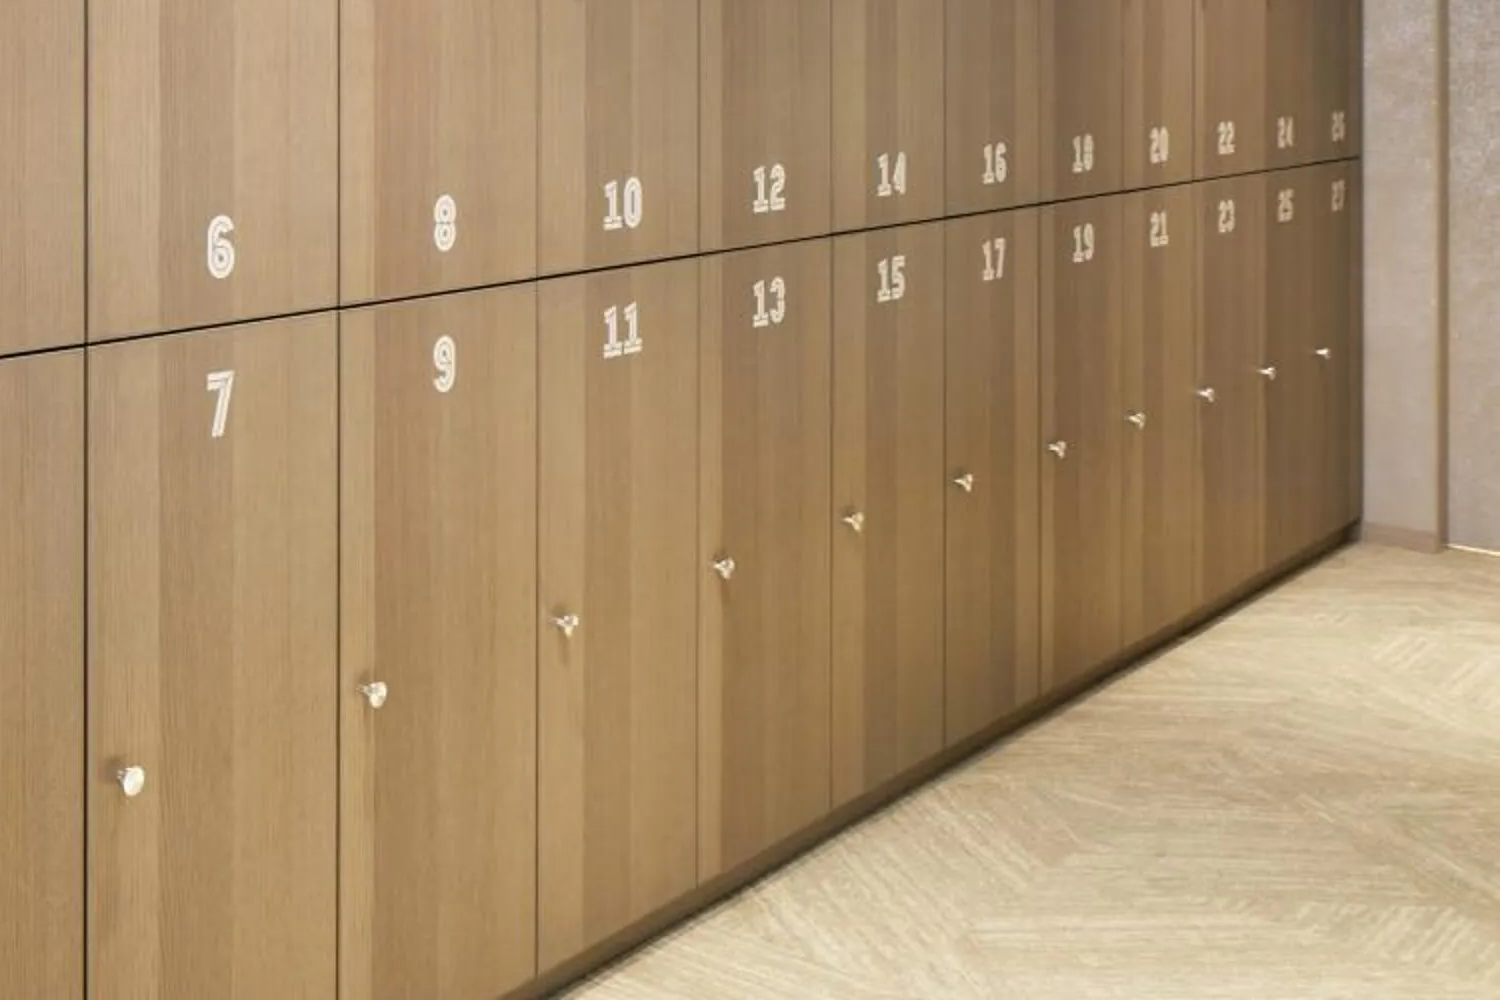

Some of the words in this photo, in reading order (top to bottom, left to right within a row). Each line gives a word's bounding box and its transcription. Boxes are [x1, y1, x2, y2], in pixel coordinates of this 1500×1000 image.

[1072, 134, 1094, 173] 18
[1150, 127, 1169, 164] 20
[1217, 121, 1235, 155] 22
[1277, 117, 1293, 149] 24
[877, 151, 906, 197] 14
[982, 142, 1007, 184] 16
[604, 176, 642, 230] 10
[753, 163, 786, 213] 12
[1278, 189, 1293, 222] 25
[433, 194, 457, 252] 8
[1150, 211, 1169, 247] 21
[1218, 199, 1235, 234] 23
[207, 214, 235, 279] 6
[982, 237, 1005, 281] 17
[1072, 223, 1094, 263] 19
[877, 255, 906, 302] 15
[752, 276, 786, 328] 13
[603, 302, 642, 359] 11
[433, 335, 456, 393] 9
[207, 370, 235, 438] 7
